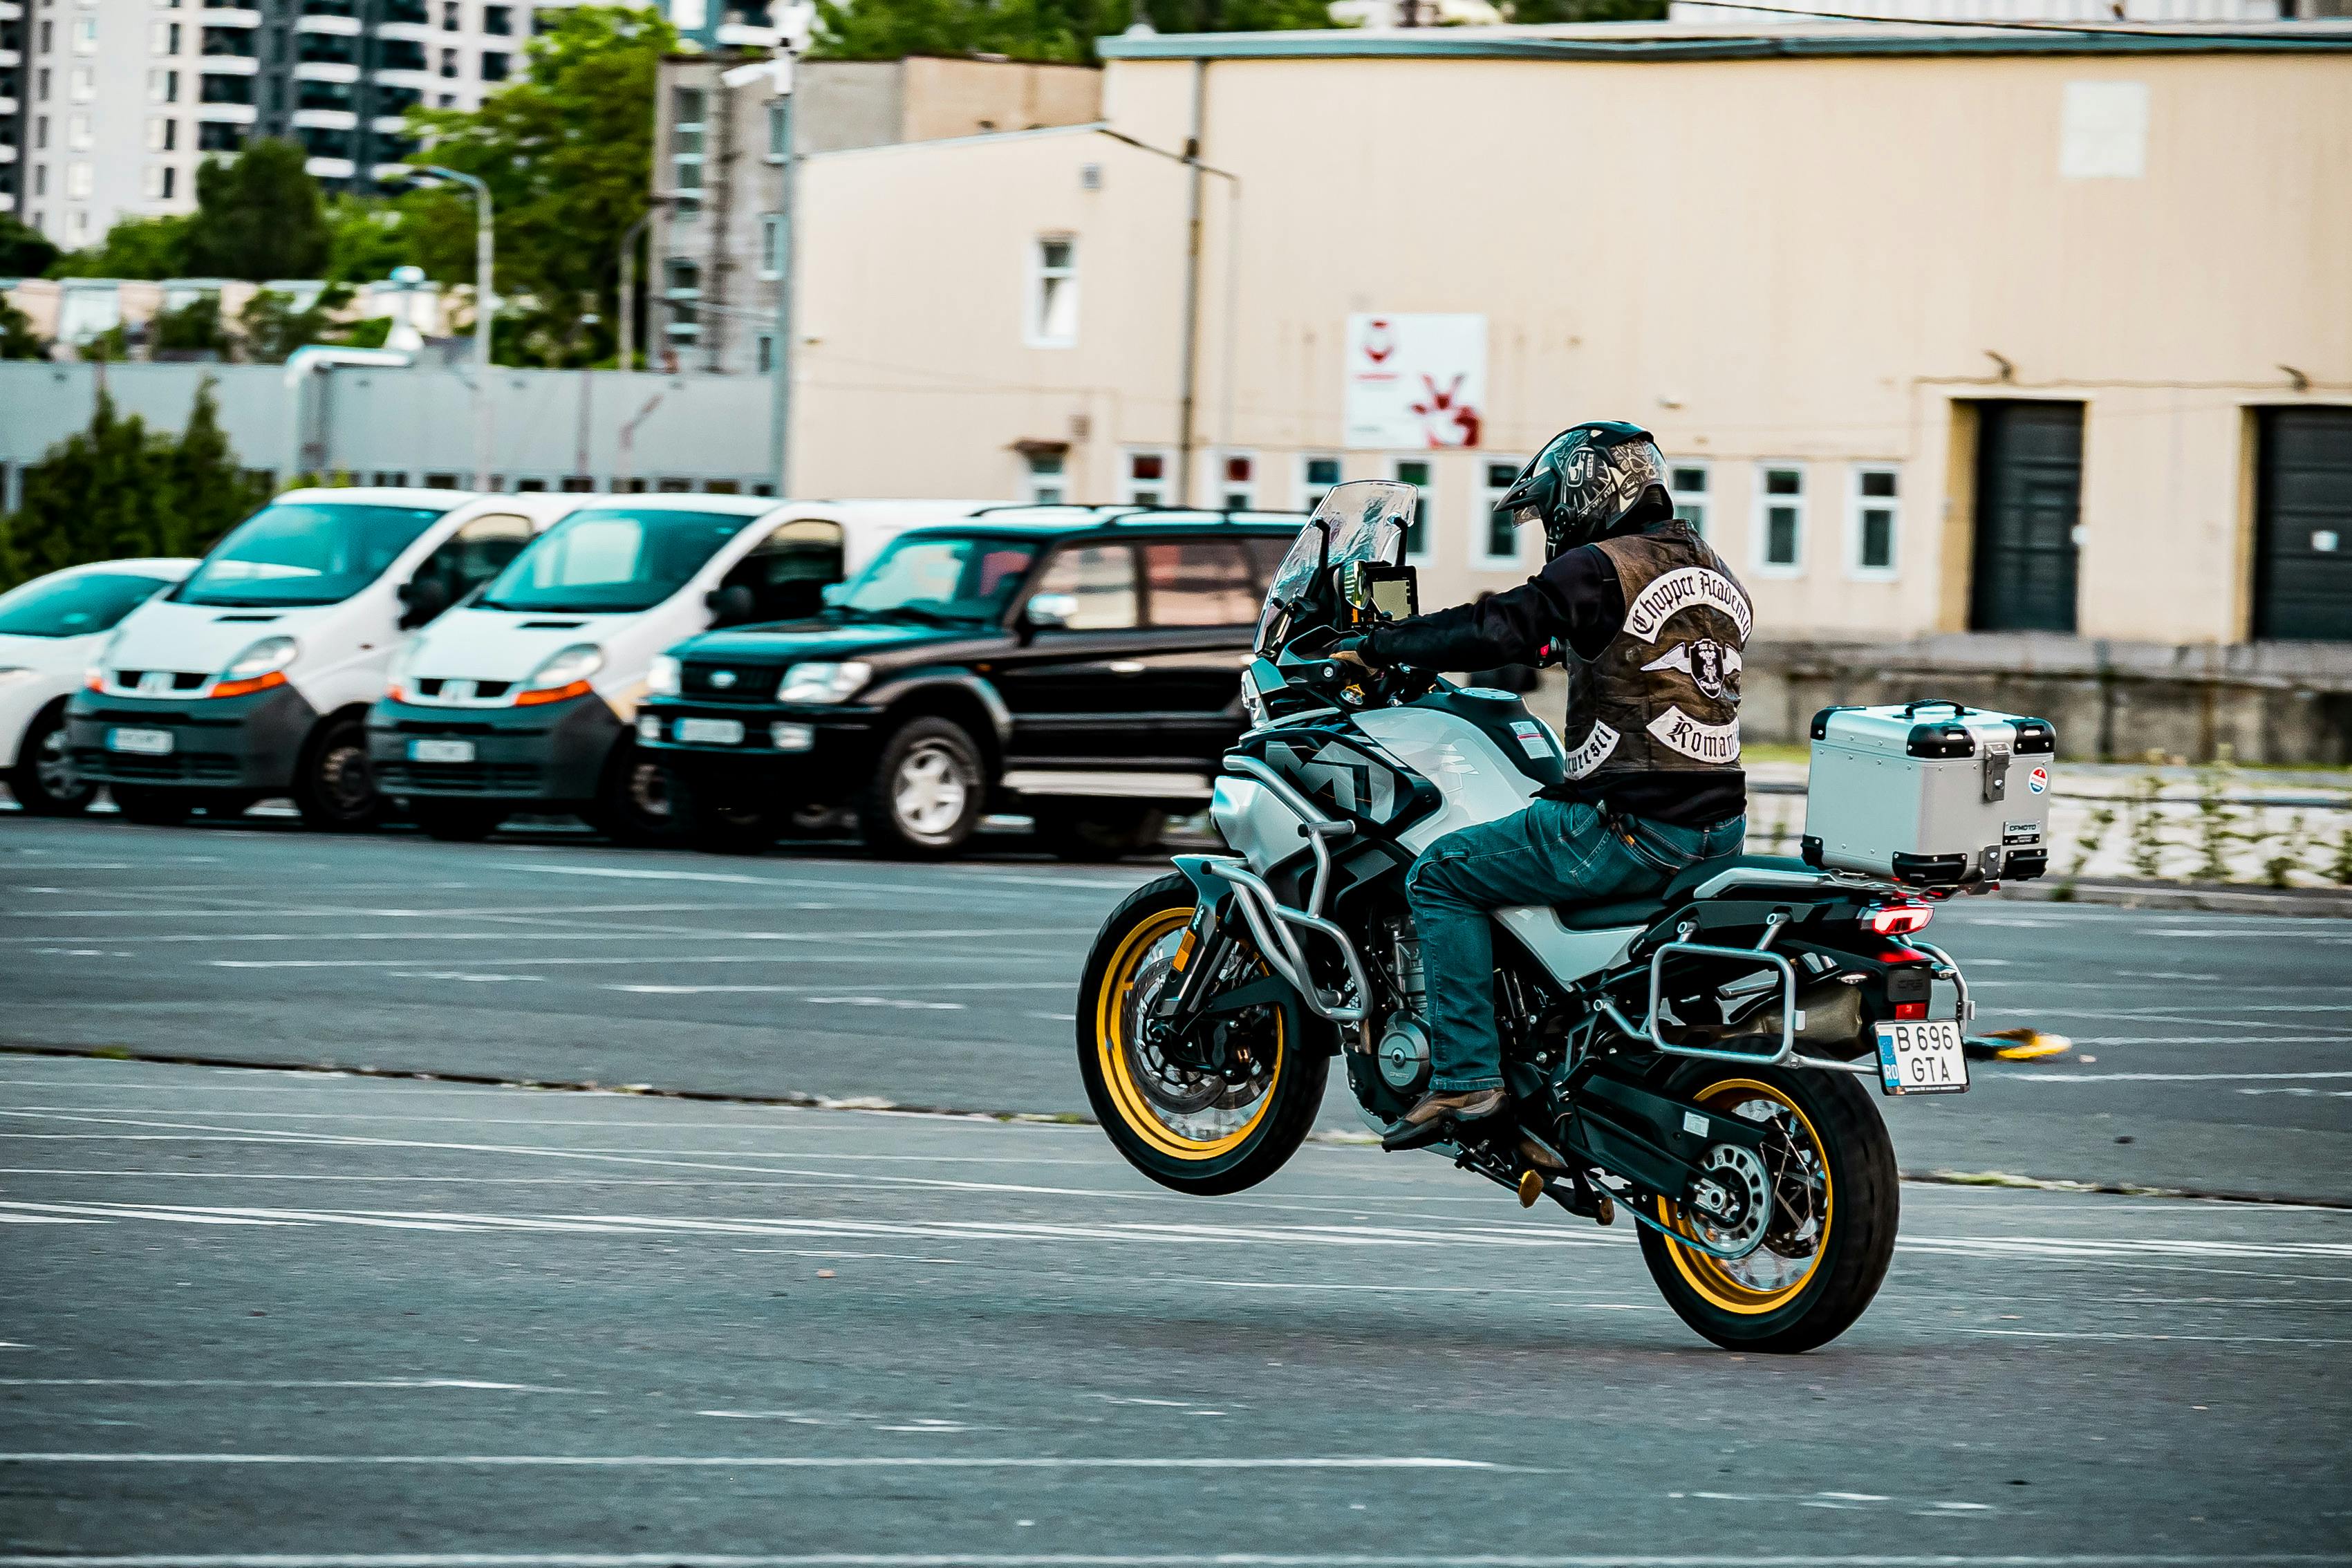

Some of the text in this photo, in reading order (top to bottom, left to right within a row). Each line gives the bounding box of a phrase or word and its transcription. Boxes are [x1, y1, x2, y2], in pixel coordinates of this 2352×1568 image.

[1632, 570, 1751, 637] Chopper Academy
[1896, 1025, 1953, 1052] B 696
[1883, 1064, 1899, 1081] RO
[1911, 1056, 1951, 1083] GTA
